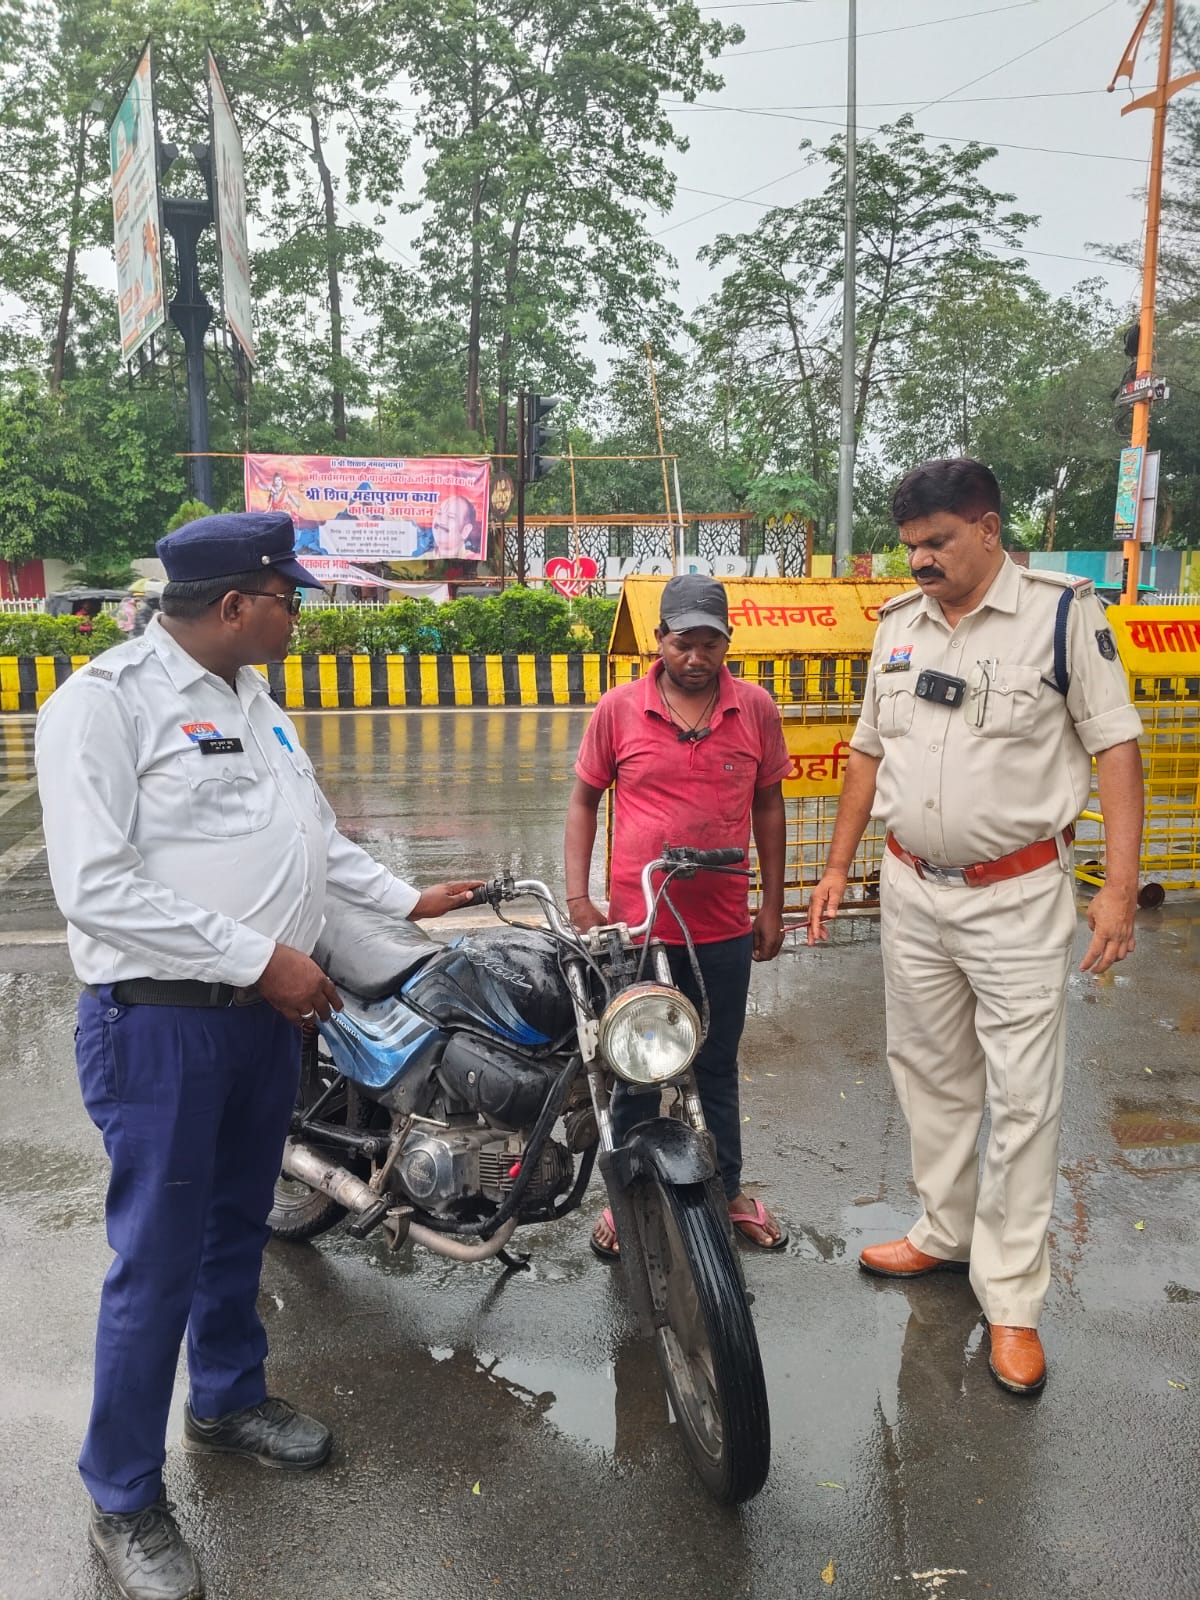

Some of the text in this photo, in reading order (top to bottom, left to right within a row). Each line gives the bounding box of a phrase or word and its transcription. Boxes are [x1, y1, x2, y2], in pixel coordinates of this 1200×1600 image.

[305, 488, 439, 505] श्री शिव महापुराण कथा
